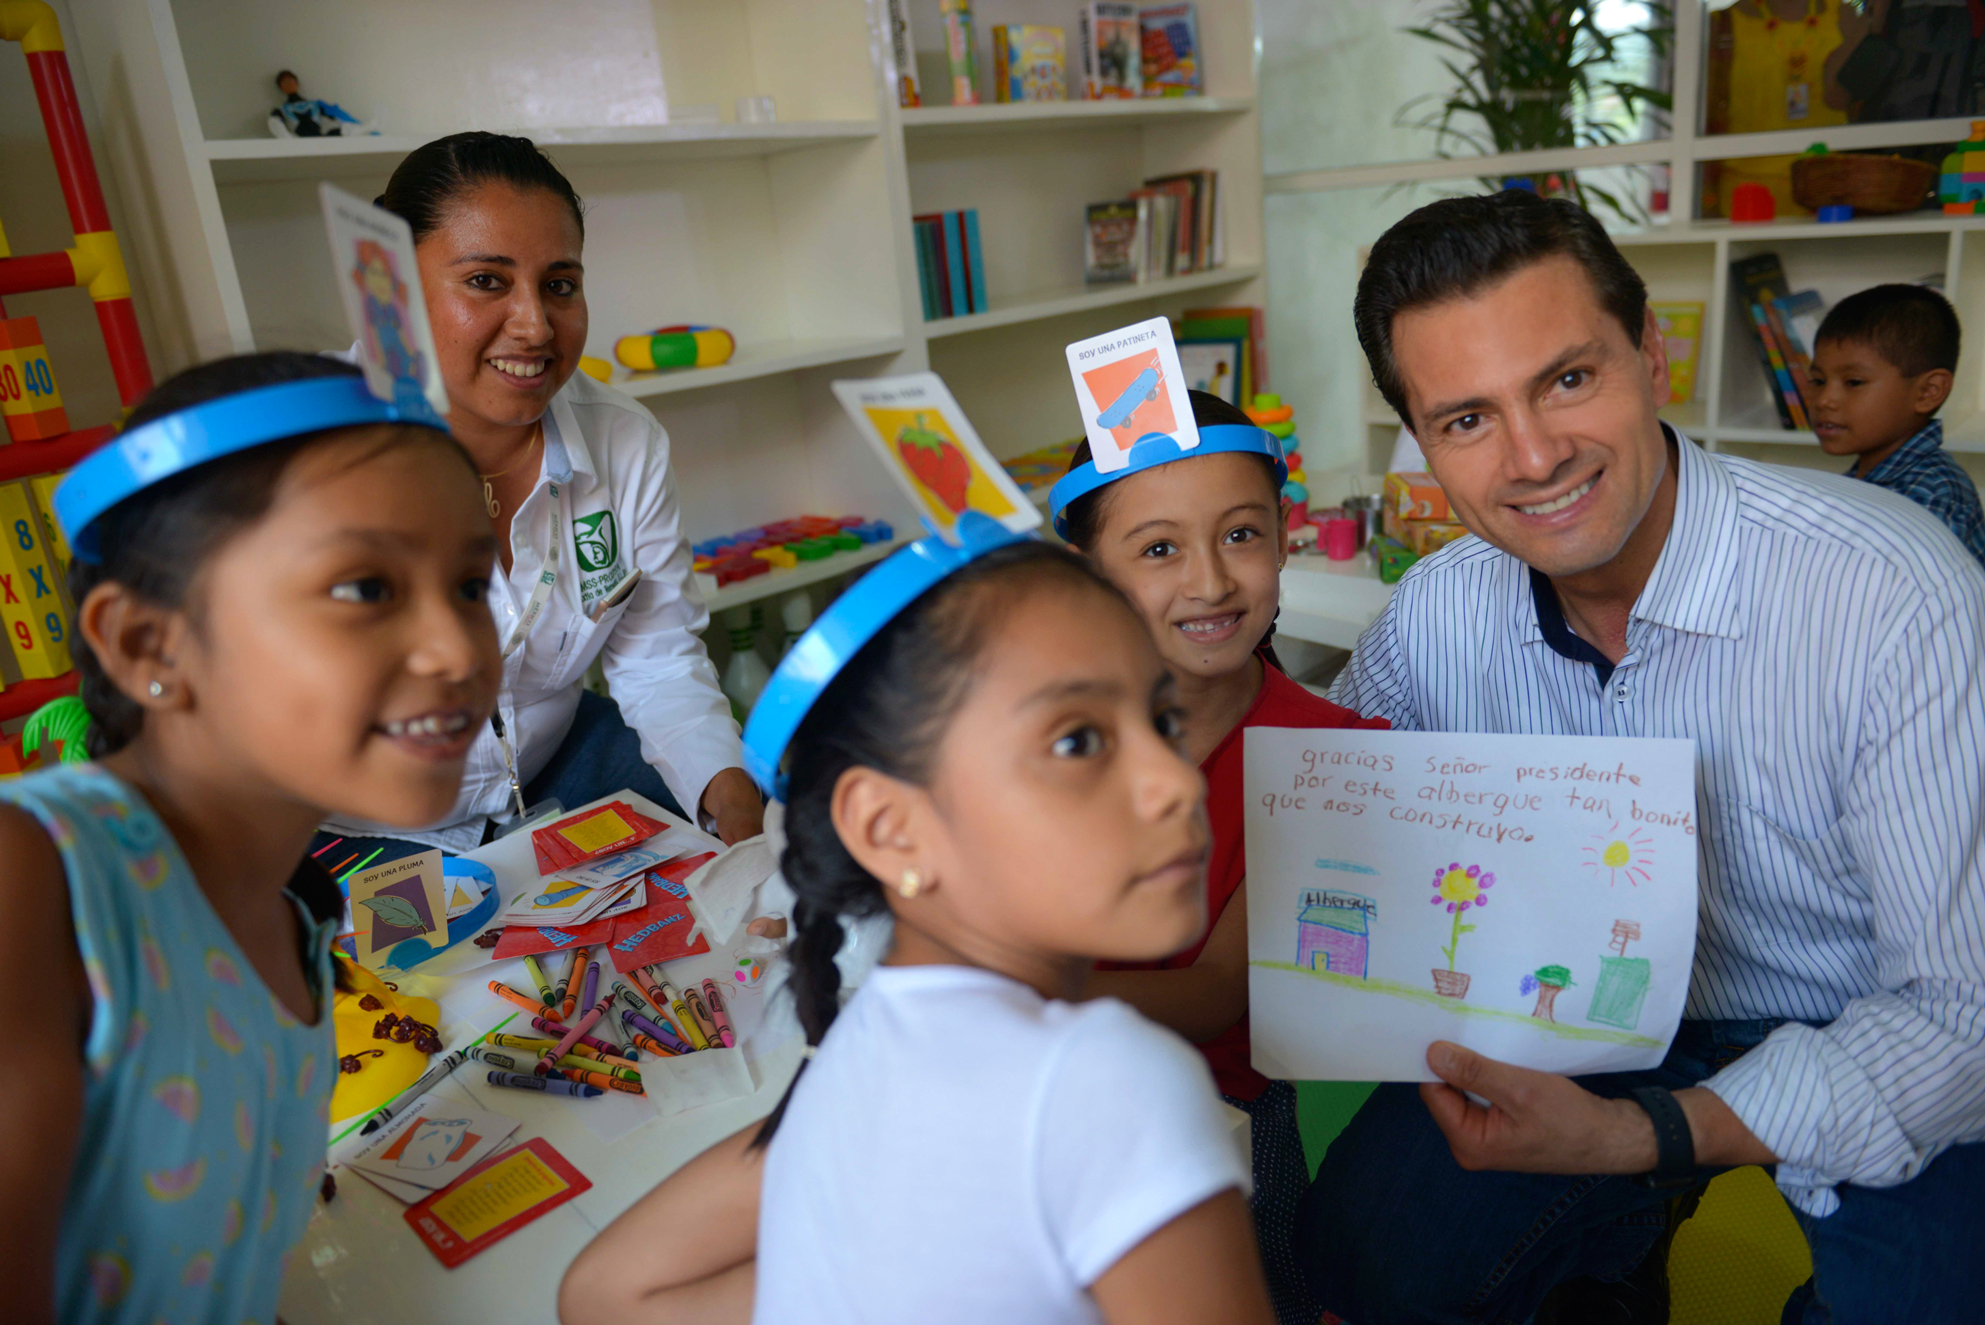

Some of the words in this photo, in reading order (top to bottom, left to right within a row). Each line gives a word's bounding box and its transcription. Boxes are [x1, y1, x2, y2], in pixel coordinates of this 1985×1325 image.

[1078, 348, 1096, 361] SOY
[1097, 343, 1116, 355] UNA
[1116, 329, 1158, 350] PATINETA
[25, 358, 53, 397] 40
[14, 519, 34, 551] 8
[45, 612, 63, 643] 9
[14, 620, 34, 650] 9
[1302, 749, 1395, 774] gracias
[1516, 762, 1641, 787] presidente
[1261, 793, 1307, 817] que
[1323, 799, 1367, 816] nos
[1294, 774, 1334, 791] por
[1344, 779, 1396, 801] este
[1417, 779, 1543, 817] albergue
[1565, 787, 1612, 819] tan
[1631, 799, 1695, 835] bonito
[363, 873, 379, 884] SOY
[381, 867, 397, 878] UNA
[399, 860, 424, 872] PLUMA
[613, 913, 686, 952] HEDBANZ
[487, 1055, 513, 1069] Crayola
[612, 1079, 641, 1093] Crayola
